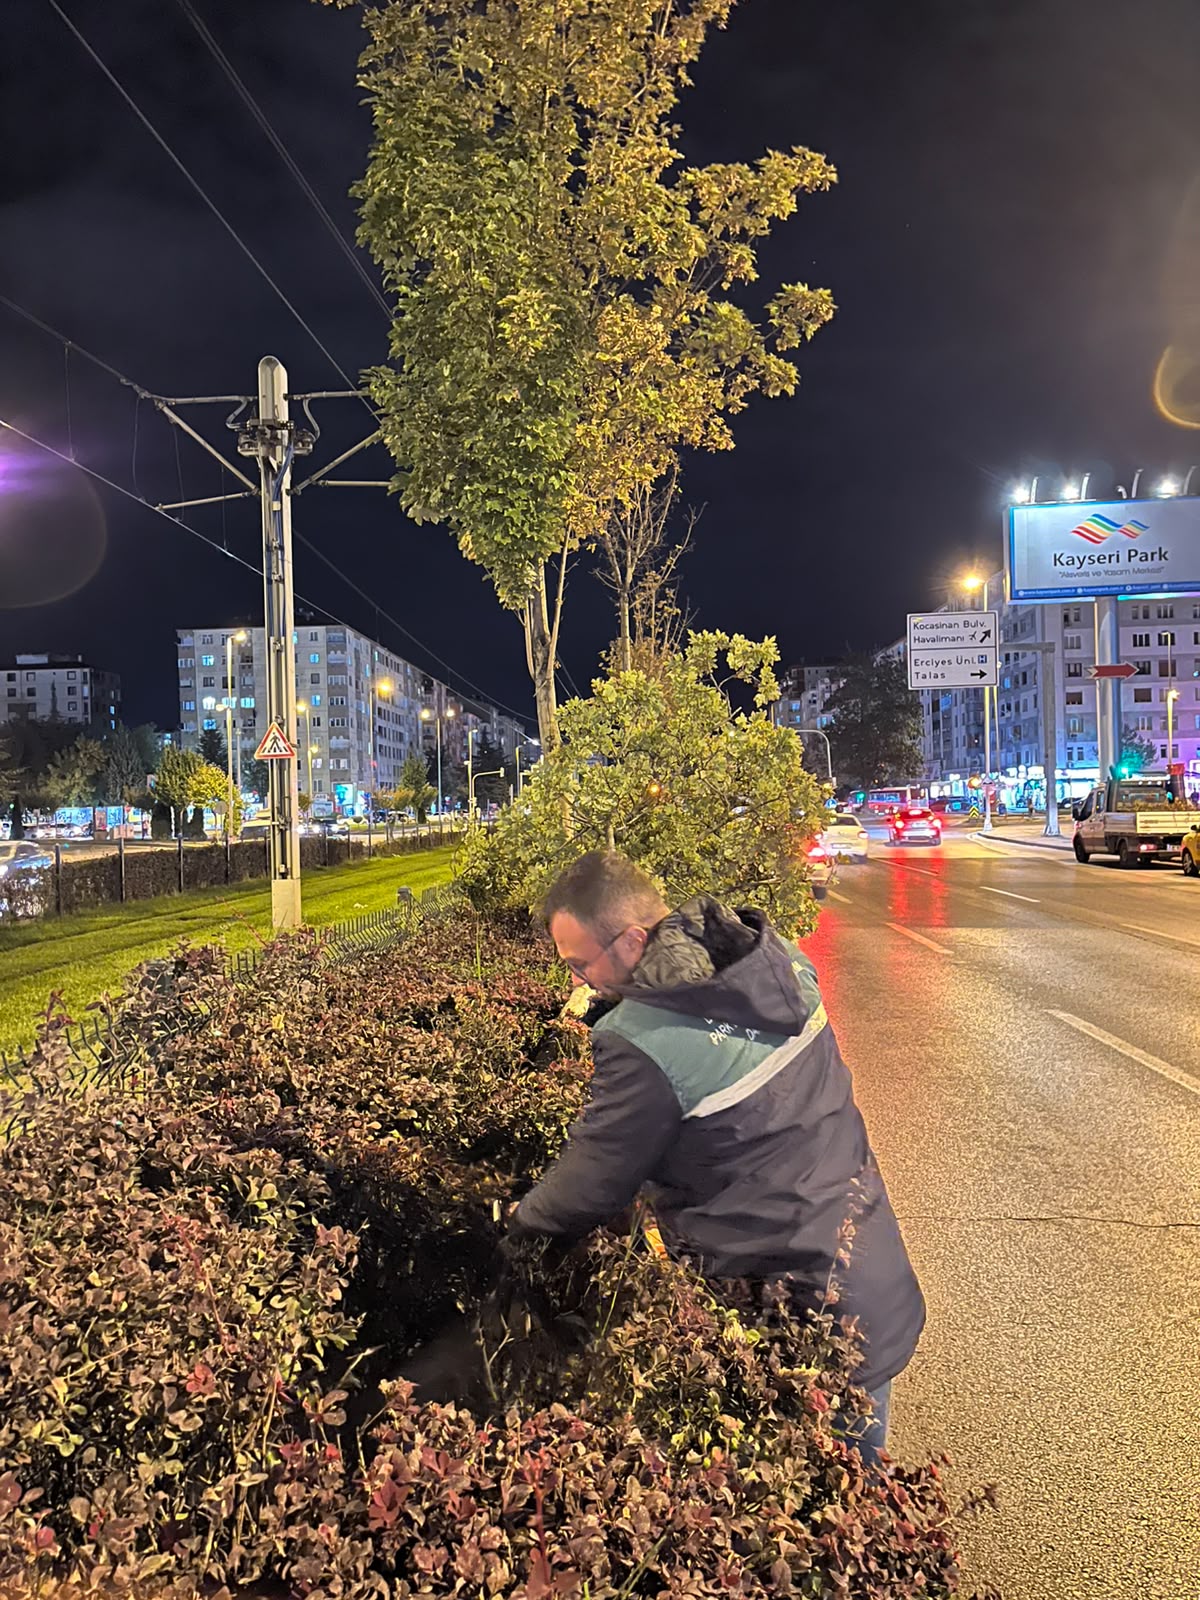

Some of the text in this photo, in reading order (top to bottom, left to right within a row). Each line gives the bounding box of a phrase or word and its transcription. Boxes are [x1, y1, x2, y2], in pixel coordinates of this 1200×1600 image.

[1053, 546, 1169, 570] Kayseri Park
[913, 620, 987, 630] Kocasinan Bulv.
[913, 635, 965, 644] Havalimanı
[914, 658, 953, 668] Erciyes
[914, 672, 946, 680] Talas
